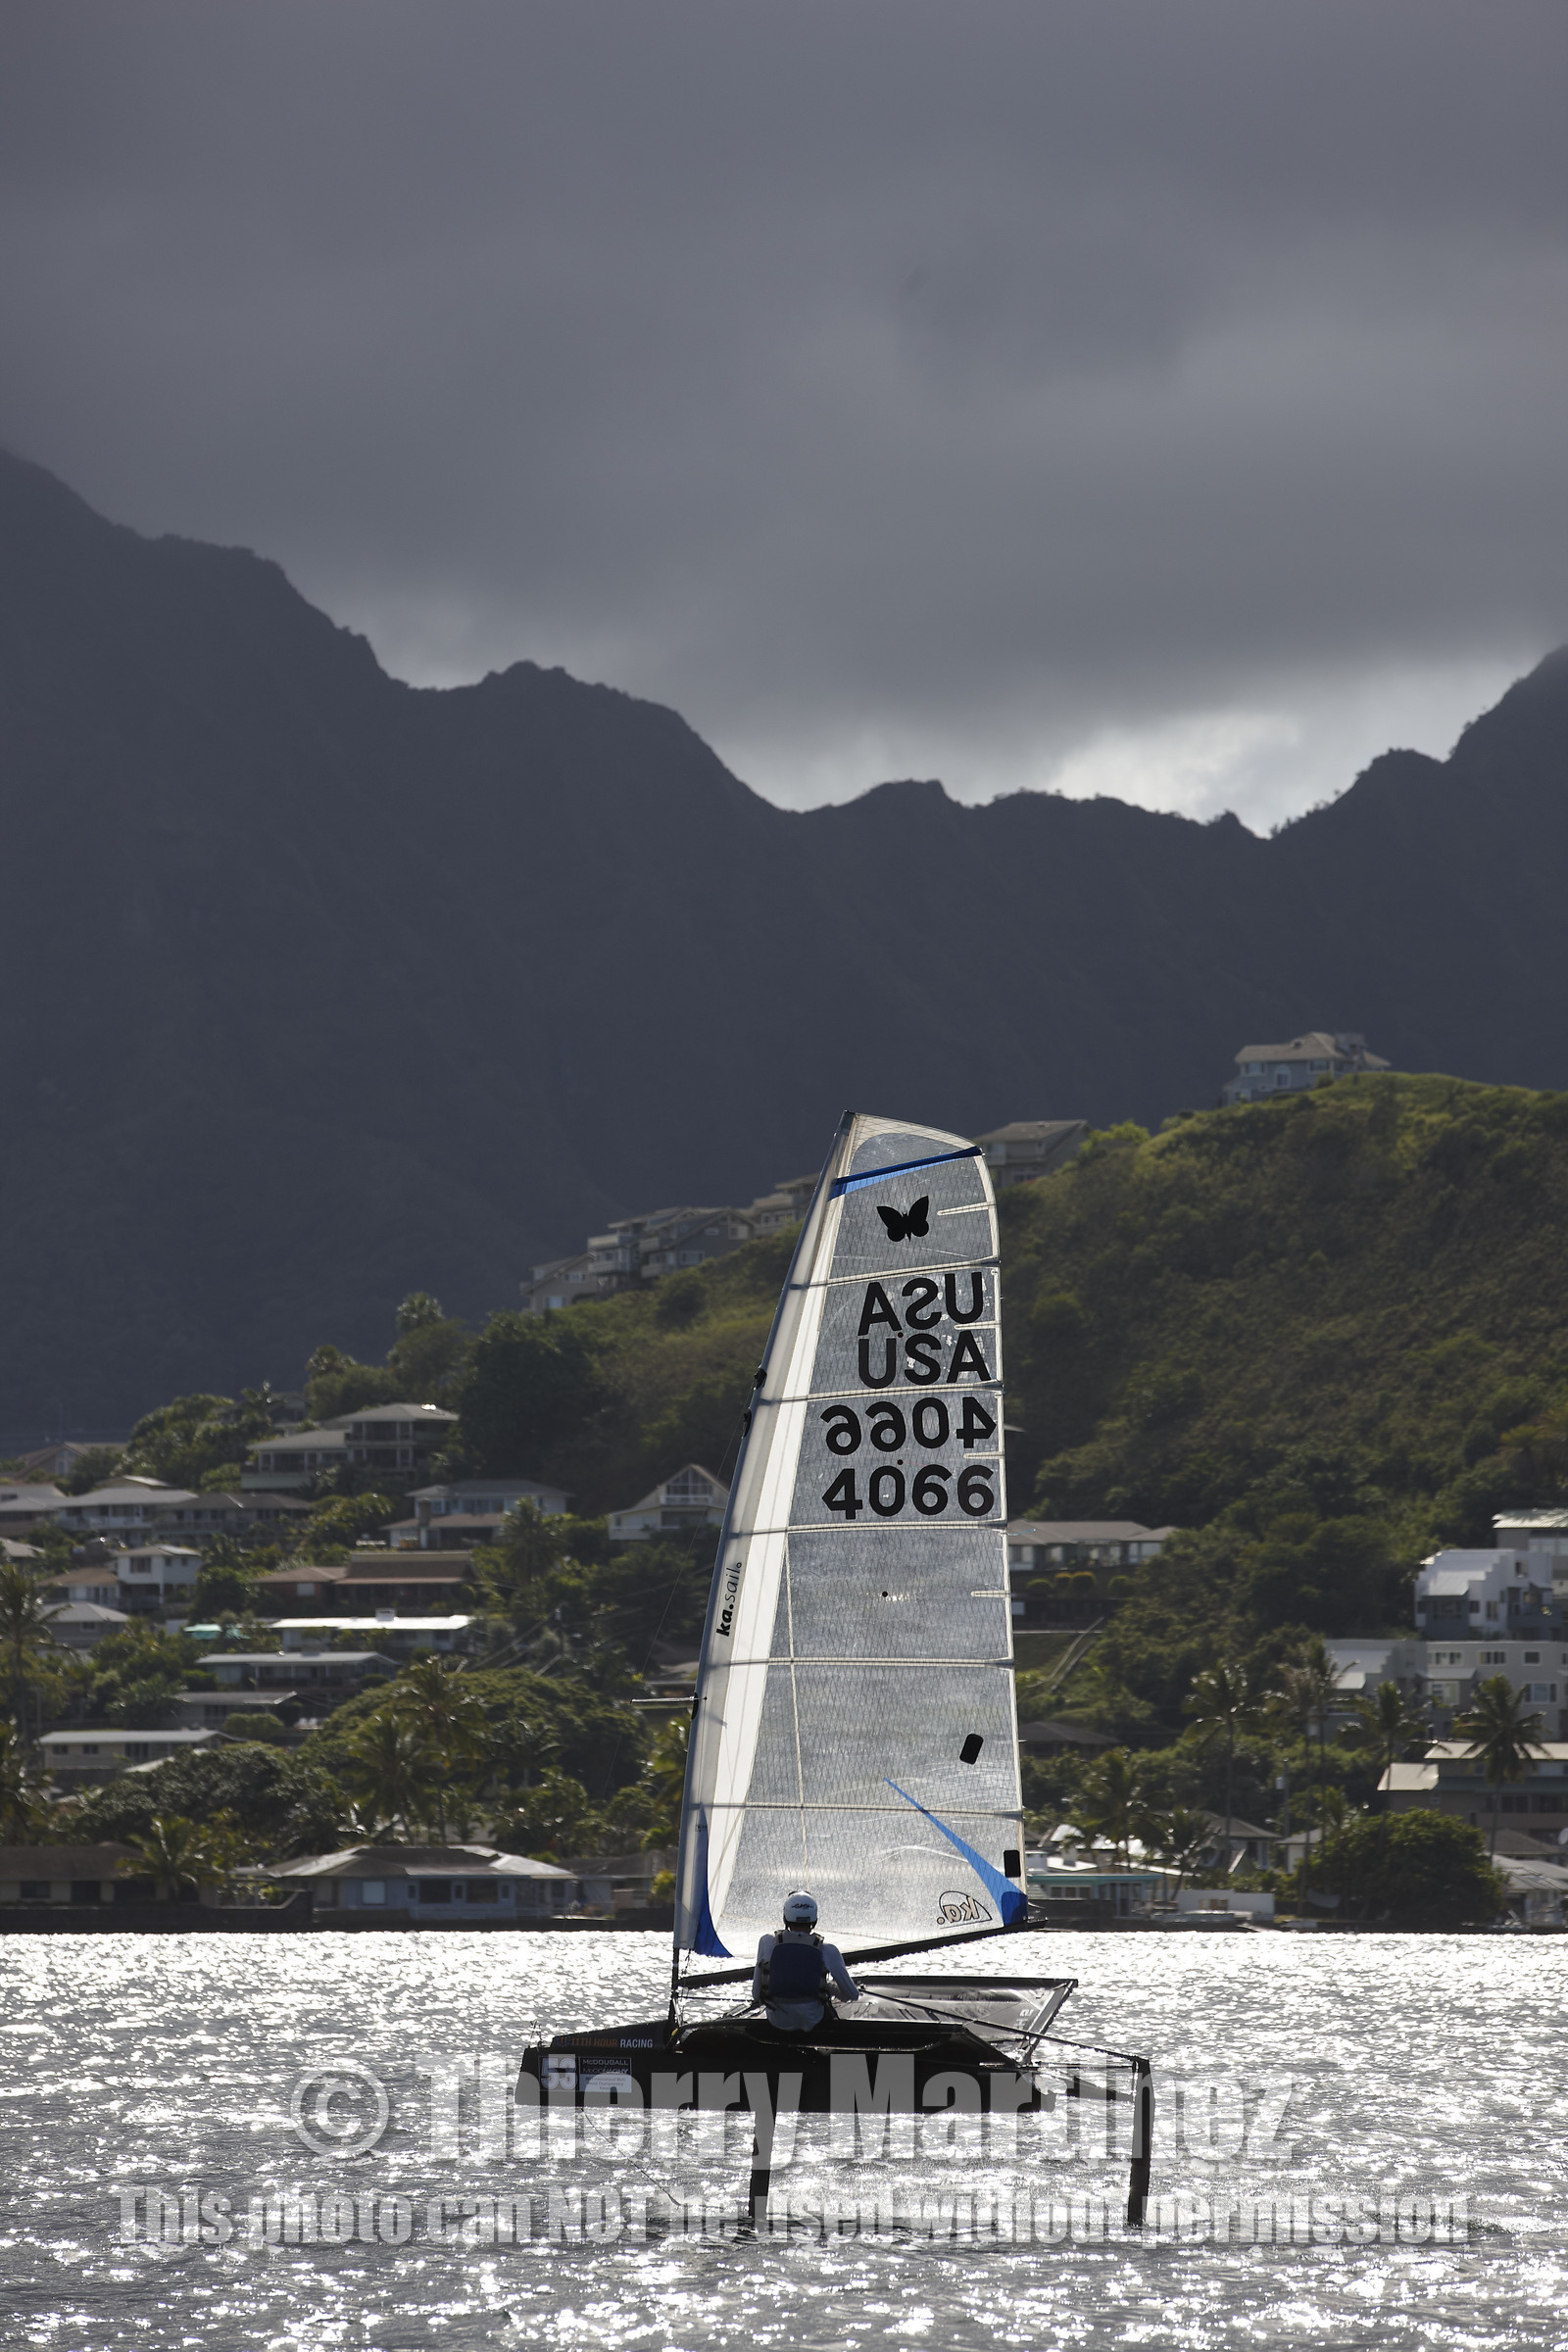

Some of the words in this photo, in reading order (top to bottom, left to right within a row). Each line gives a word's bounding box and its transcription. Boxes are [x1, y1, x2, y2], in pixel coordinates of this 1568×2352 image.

[858, 1330, 992, 1389] USA
[822, 1464, 995, 1520] 4066
[594, 2038, 617, 2048] HOUR
[620, 2038, 654, 2049] RACING
[541, 2057, 578, 2090] 53
